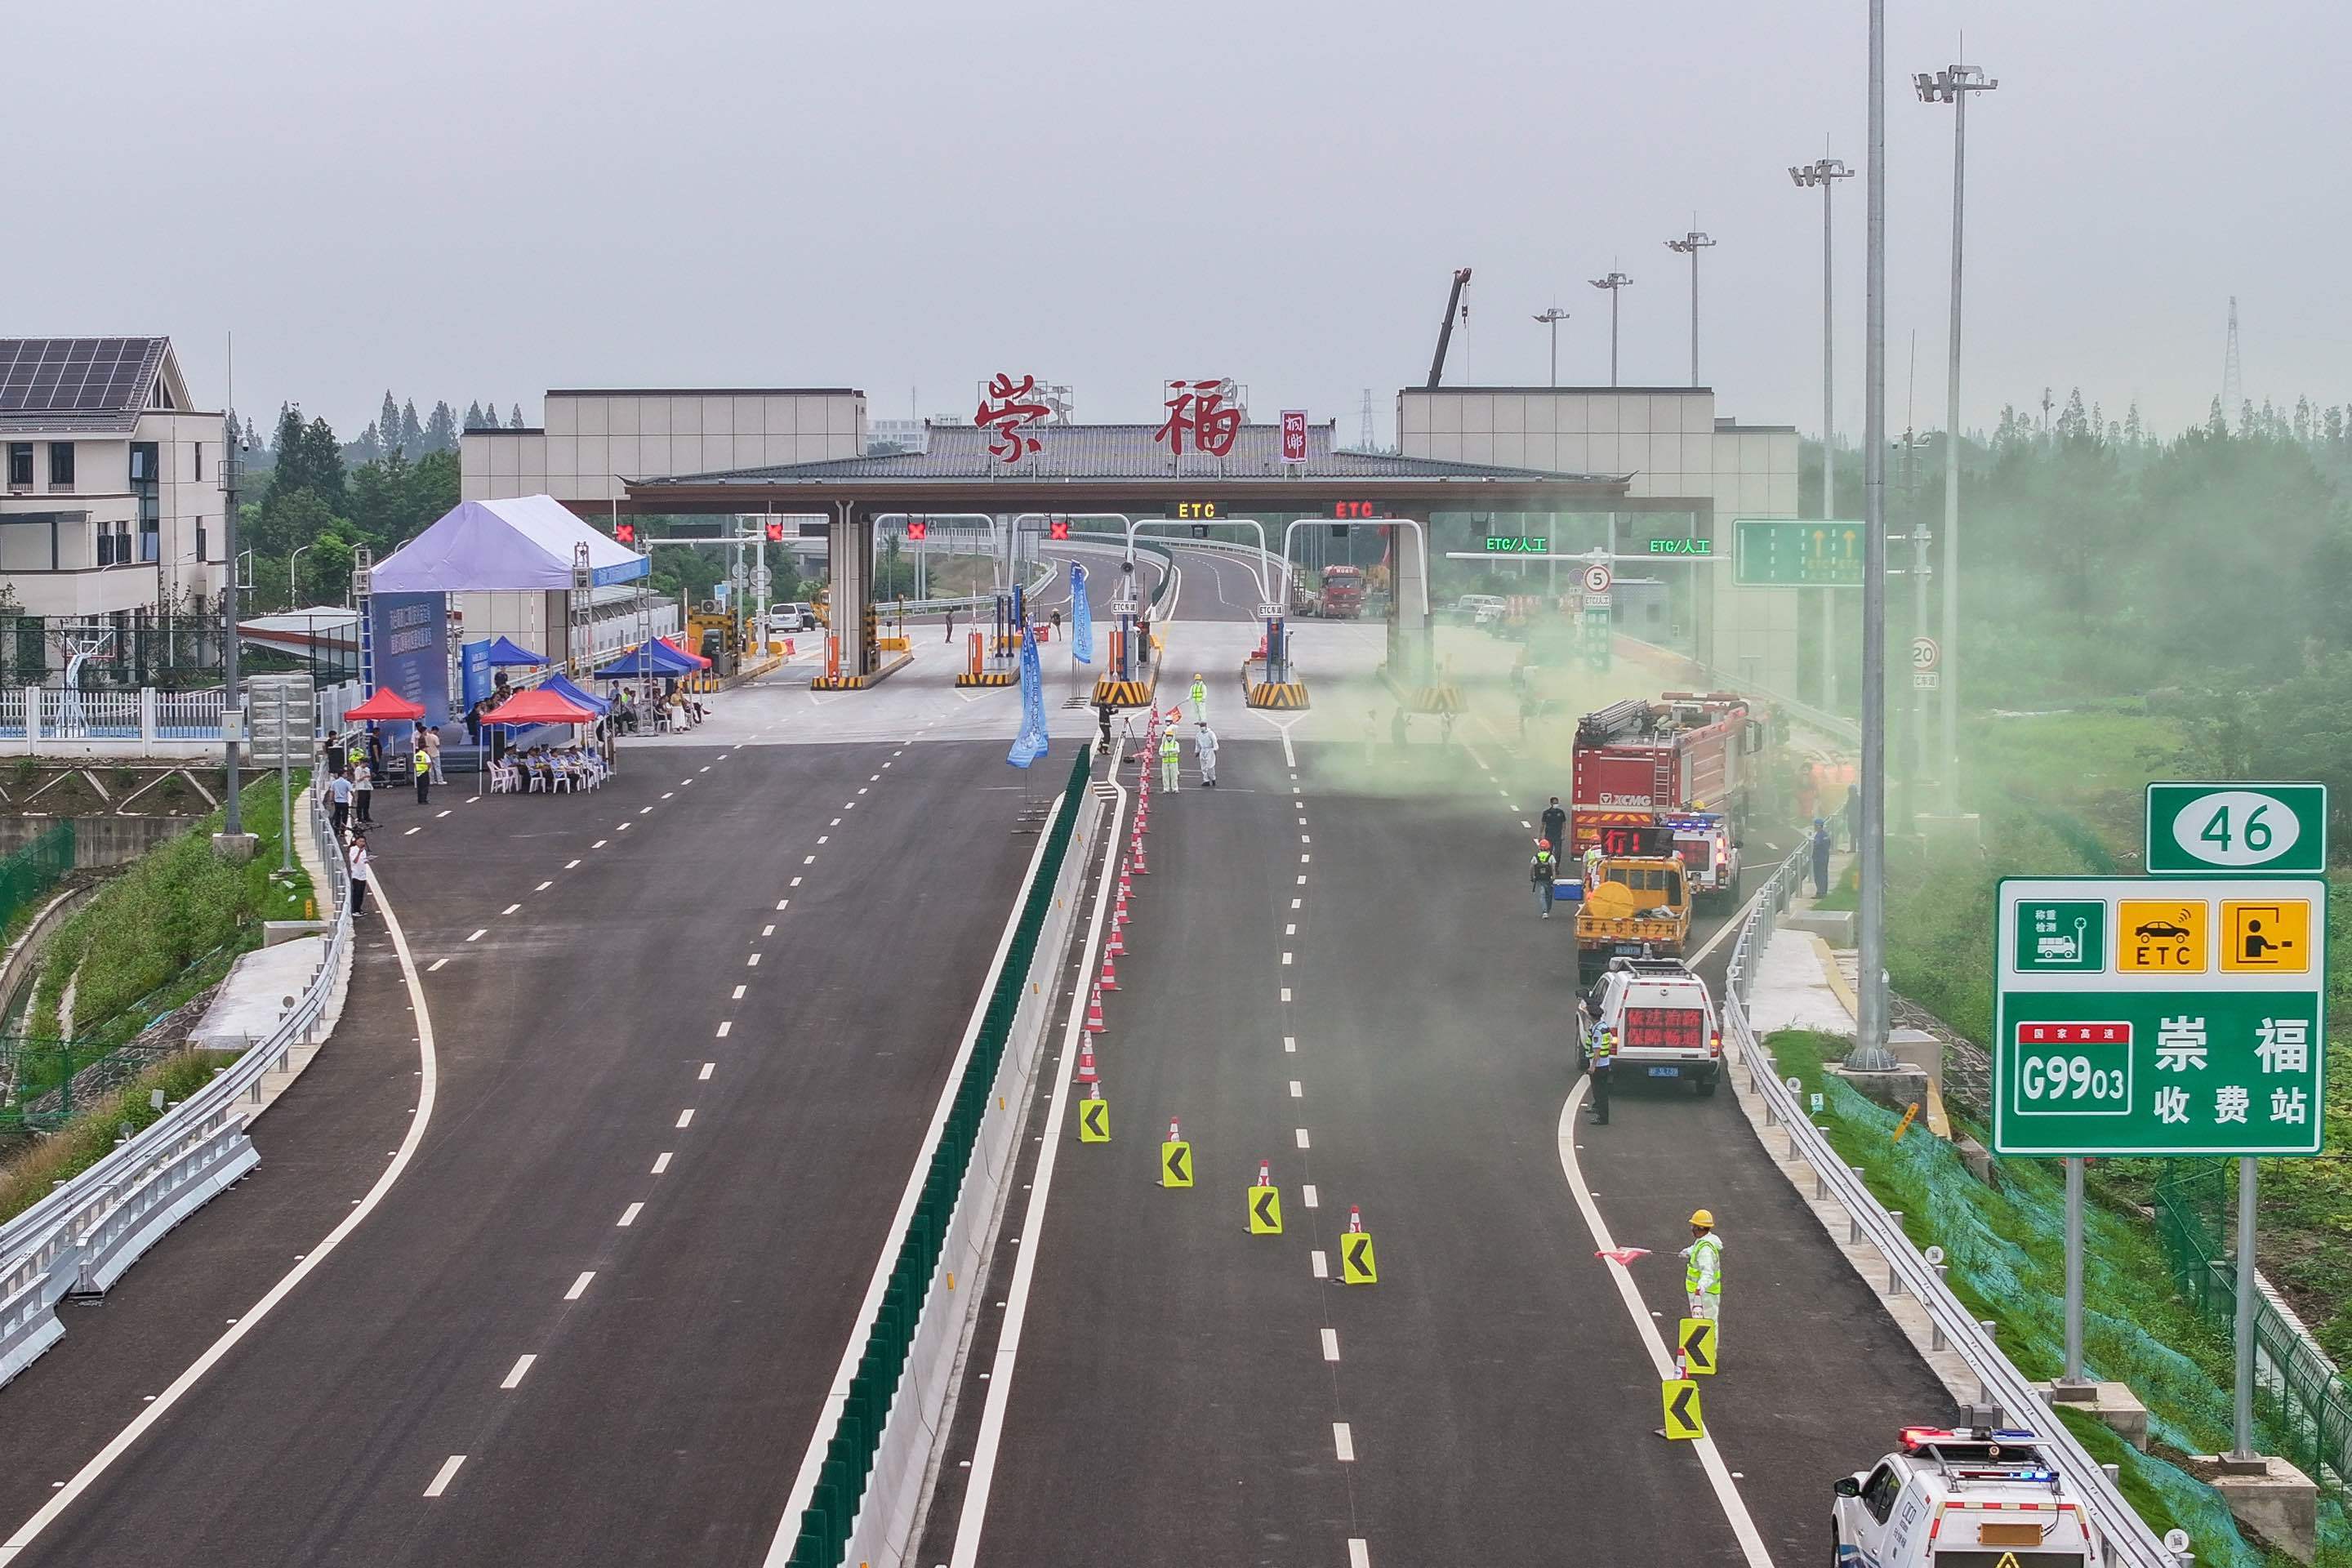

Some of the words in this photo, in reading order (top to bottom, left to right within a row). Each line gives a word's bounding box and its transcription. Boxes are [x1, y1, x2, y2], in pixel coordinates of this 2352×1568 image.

[1178, 501, 1216, 519] ETC
[1334, 501, 1374, 518] ETC
[1486, 537, 1548, 553] ETC/人工
[1649, 540, 1712, 555] ETC/人工
[1592, 572, 1603, 586] 5
[1913, 647, 1933, 662] 20
[1613, 795, 1652, 807] XCMG
[2199, 804, 2273, 853] 46
[2034, 909, 2056, 920] 称重
[2034, 922, 2056, 933] 检测
[2136, 946, 2191, 965] ETC
[2034, 1028, 2114, 1040] 国家高速
[2154, 1015, 2310, 1074] 崇福
[2022, 1055, 2125, 1100] G9903
[2153, 1085, 2306, 1125] 收费站
